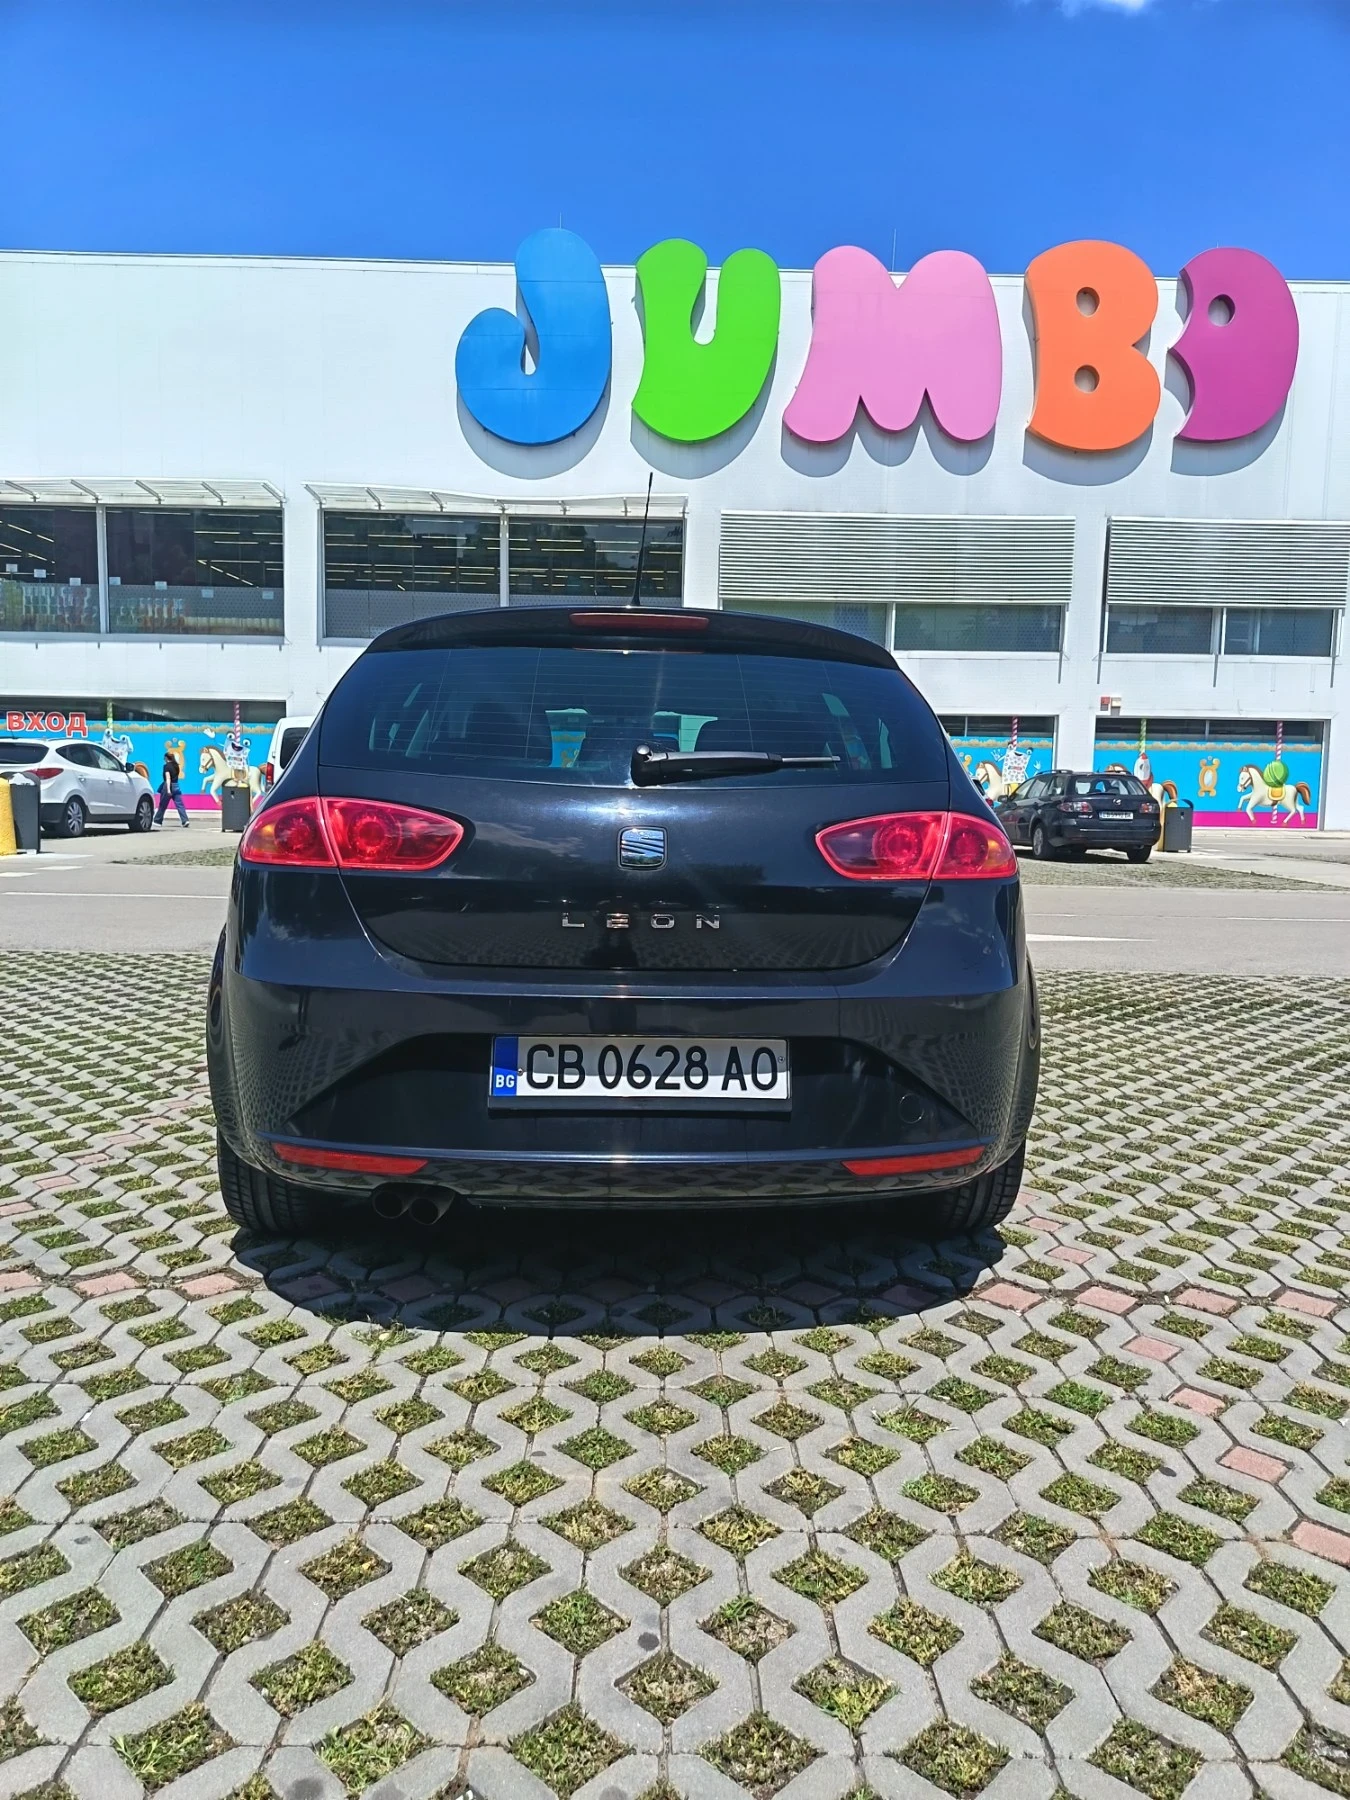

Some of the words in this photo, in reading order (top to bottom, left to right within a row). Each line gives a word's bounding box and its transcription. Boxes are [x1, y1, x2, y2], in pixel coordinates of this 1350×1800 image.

[455, 227, 1299, 451] JUMBO
[6, 711, 88, 737] ВХОД
[561, 912, 720, 929] LEON
[495, 1074, 515, 1088] BG
[526, 1043, 586, 1090] CB
[598, 1044, 708, 1091] 0628
[721, 1045, 778, 1091] AO
